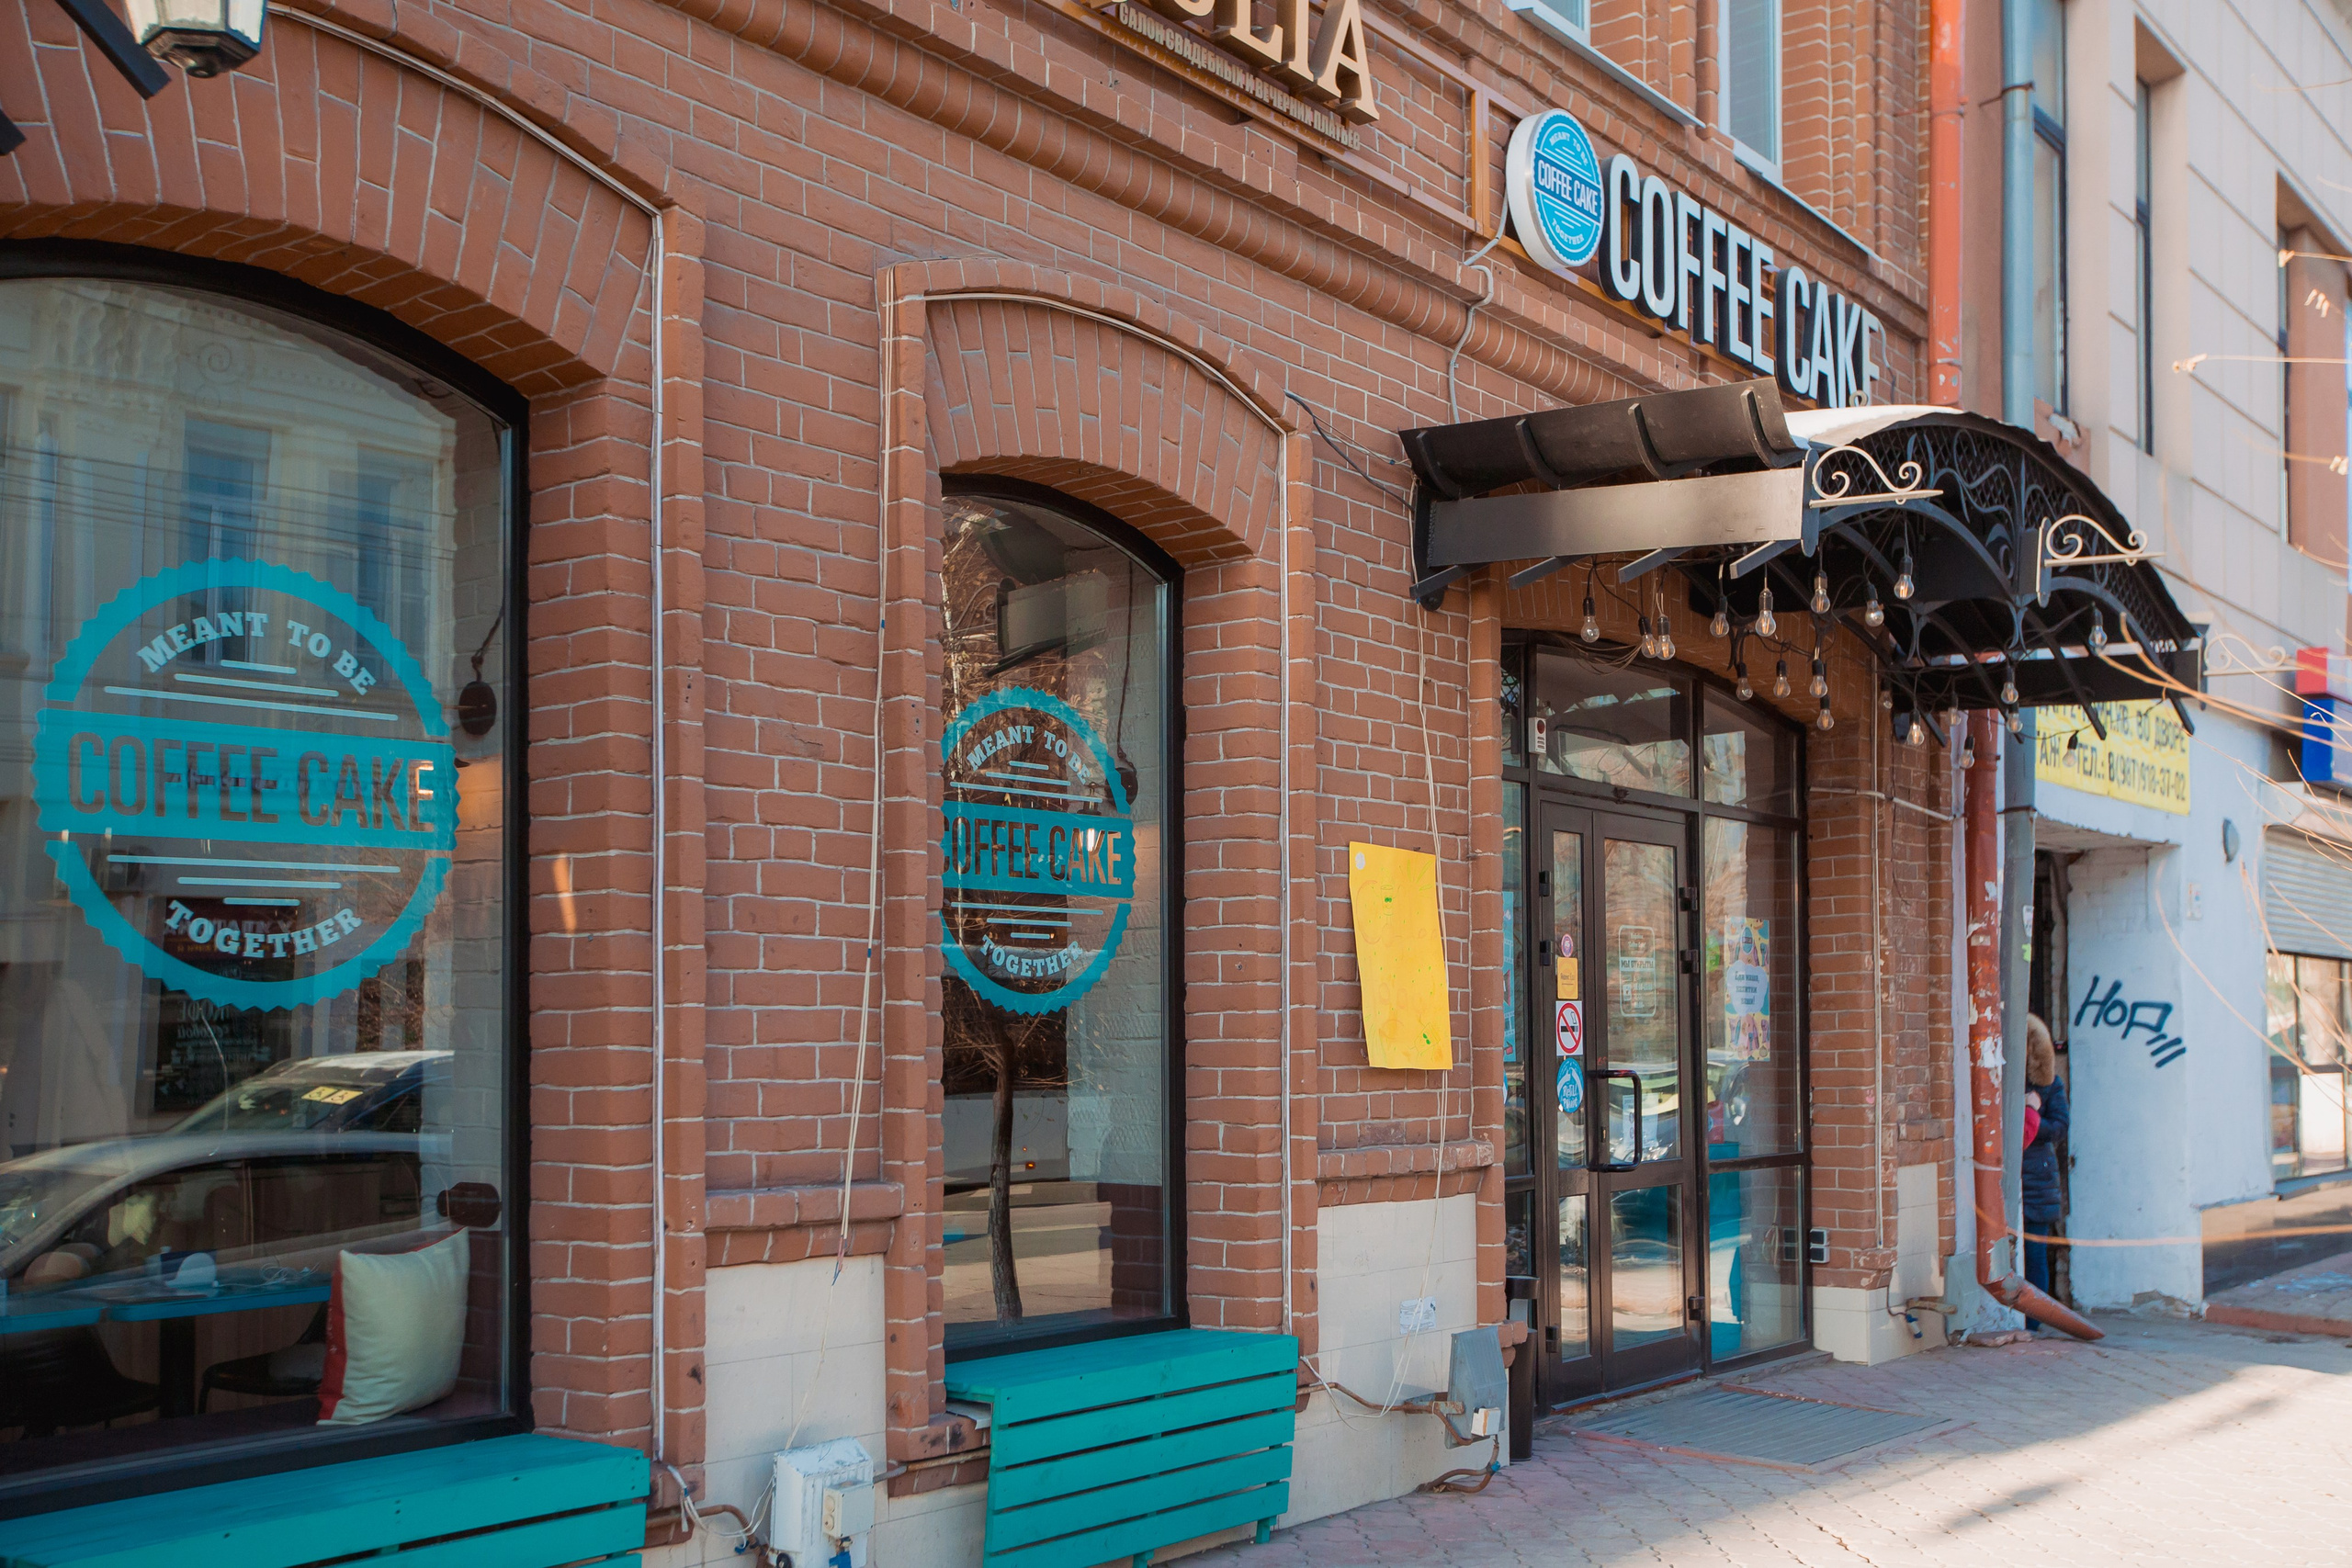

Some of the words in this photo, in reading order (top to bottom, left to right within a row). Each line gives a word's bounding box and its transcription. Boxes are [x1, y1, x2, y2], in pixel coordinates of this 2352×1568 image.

[1119, 2, 1165, 46] САЛОН
[1165, 28, 1244, 89] СВАДЕБНЫХ
[1245, 72, 1254, 95] И
[1255, 77, 1312, 127] ВЕЧЕРНИХ
[1313, 109, 1361, 151] ПЛАТЬЕВ
[1573, 138, 1581, 152] TO
[1538, 159, 1573, 201] COFFEE
[1573, 179, 1599, 217] CAKE
[1551, 218, 1585, 245] TOGETHER
[1608, 152, 1775, 377] COFFEE
[1782, 265, 1880, 408] CAKE
[136, 611, 268, 673] MEANT
[286, 618, 333, 660] TO
[332, 649, 377, 695] BE
[67, 730, 280, 824] COFFEE
[298, 750, 435, 833] CAKE
[966, 725, 1035, 773] MEANT
[1043, 730, 1068, 759] TO
[1068, 750, 1091, 785] BE
[1049, 825, 1123, 886] CAKE
[165, 899, 363, 958] TOGETHER
[979, 934, 1084, 977] TOGETHER
